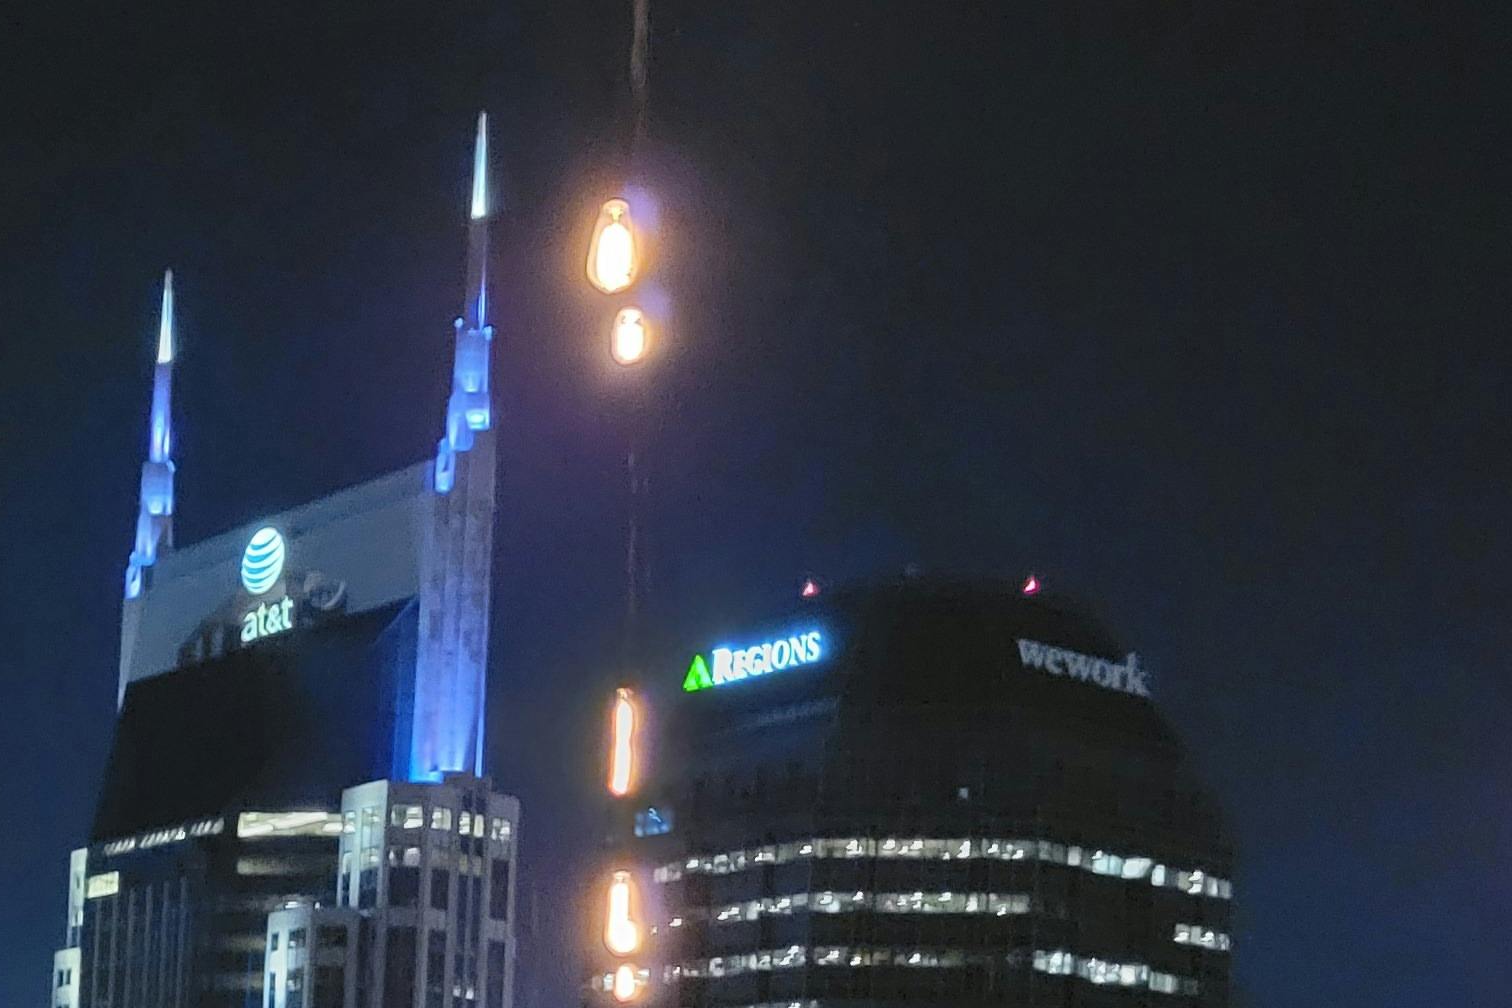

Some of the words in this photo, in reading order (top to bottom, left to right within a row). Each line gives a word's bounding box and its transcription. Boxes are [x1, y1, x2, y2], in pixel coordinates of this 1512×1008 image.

[240, 595, 294, 642] at&t
[711, 631, 822, 685] REGIONS
[1017, 638, 1152, 698] wework
